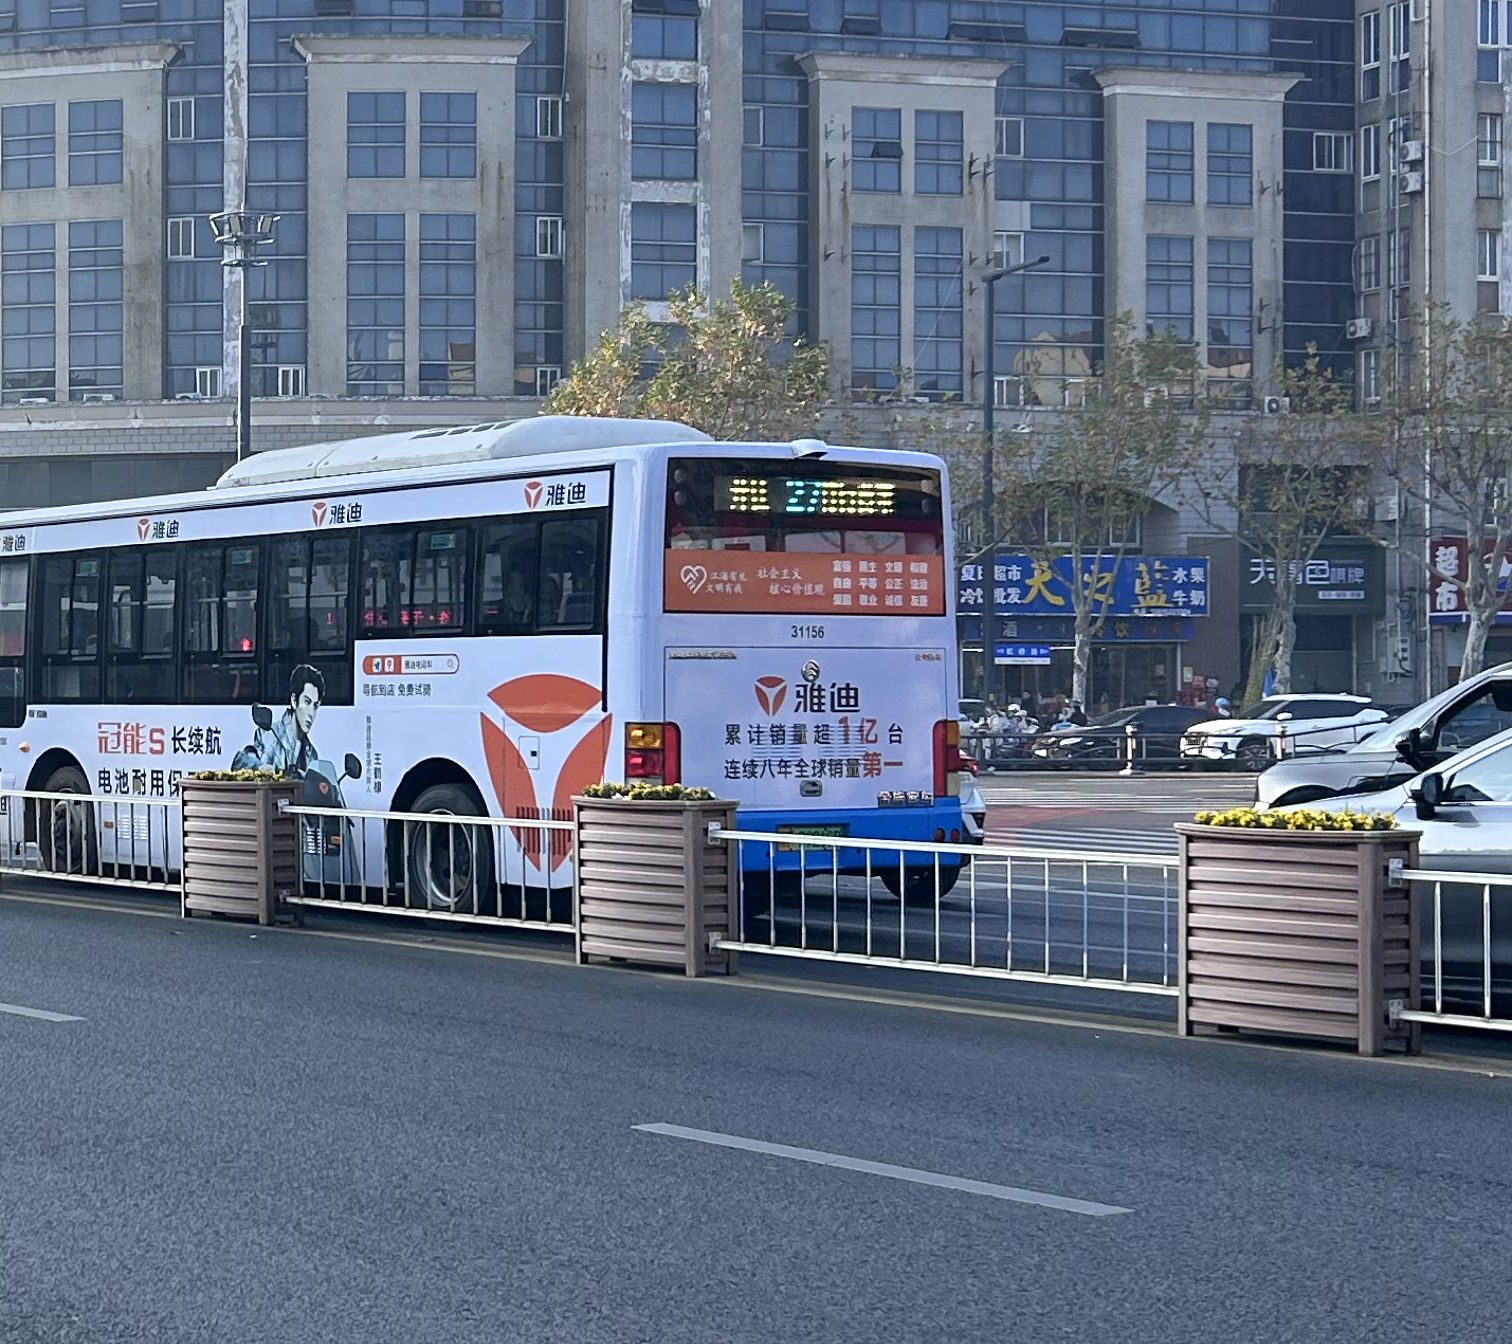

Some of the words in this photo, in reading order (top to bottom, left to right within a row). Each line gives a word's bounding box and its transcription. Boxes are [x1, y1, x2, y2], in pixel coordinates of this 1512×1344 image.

[545, 481, 587, 507] 雅迪
[329, 502, 363, 525] 雅迪
[152, 519, 180, 539] 雅迪
[2, 533, 26, 552] 雅迪
[757, 566, 802, 580] 社会主义
[1172, 567, 1205, 584] 水果
[1435, 546, 1459, 611] 超市
[769, 583, 826, 596] 核心价值观
[1172, 589, 1205, 607] 牛奶
[791, 625, 825, 639] 31156
[794, 682, 860, 713] 雅迪
[97, 722, 165, 755] 冠能S
[171, 725, 222, 755] 长续航
[724, 751, 904, 780] 连续八年全球销量第一
